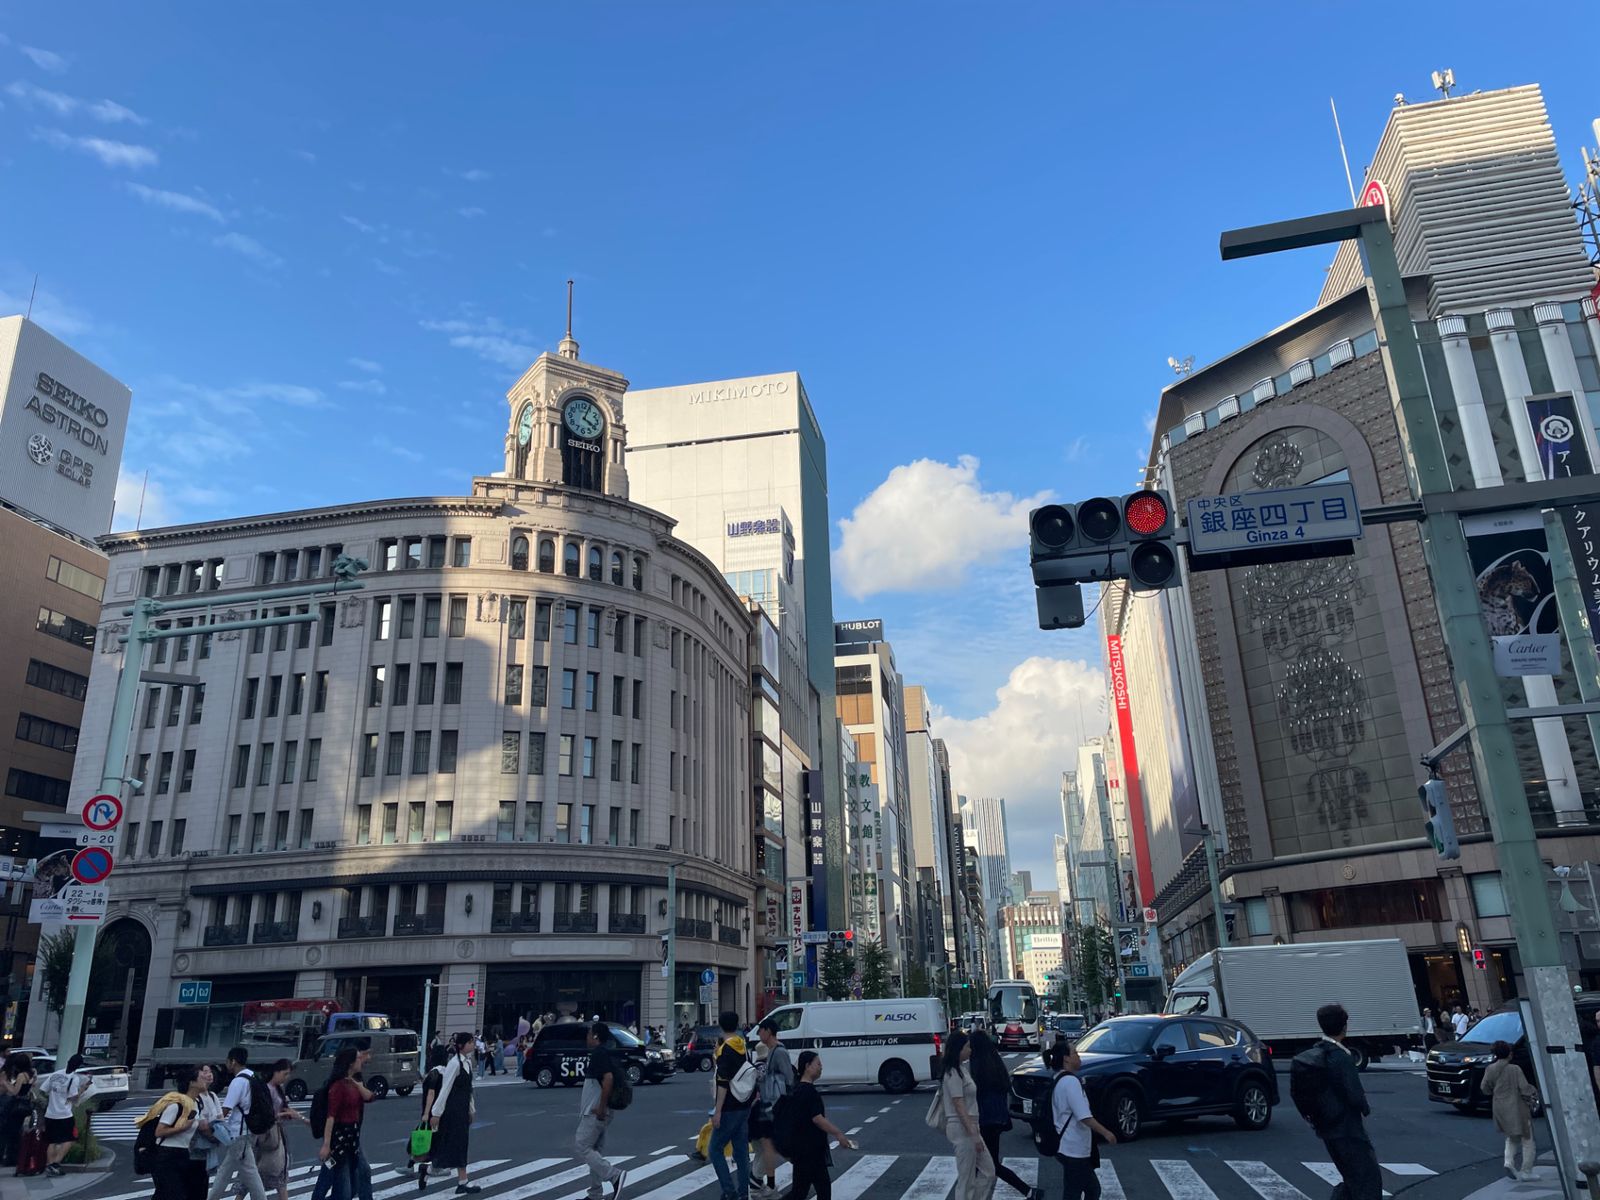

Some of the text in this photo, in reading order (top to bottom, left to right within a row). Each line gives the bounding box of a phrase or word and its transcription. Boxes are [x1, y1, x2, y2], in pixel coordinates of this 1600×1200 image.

[36, 372, 109, 428] SEIKO
[689, 382, 789, 405] MIKIMOTO
[25, 395, 109, 456] ASTRON
[567, 438, 600, 453] SEIKO
[59, 449, 94, 478] GPS
[56, 463, 92, 489] SOLAR
[1198, 495, 1242, 510] 中央区
[727, 518, 779, 537] 山野楽器
[1200, 498, 1348, 534] 銀座四丁目
[1246, 527, 1305, 543] Ginza 4
[841, 621, 881, 630] HUBLOT
[1508, 640, 1548, 654] Cartier
[1110, 640, 1127, 709] MITSUKOSHI
[811, 802, 823, 864] 山野楽器
[884, 1013, 918, 1022] ALSOK
